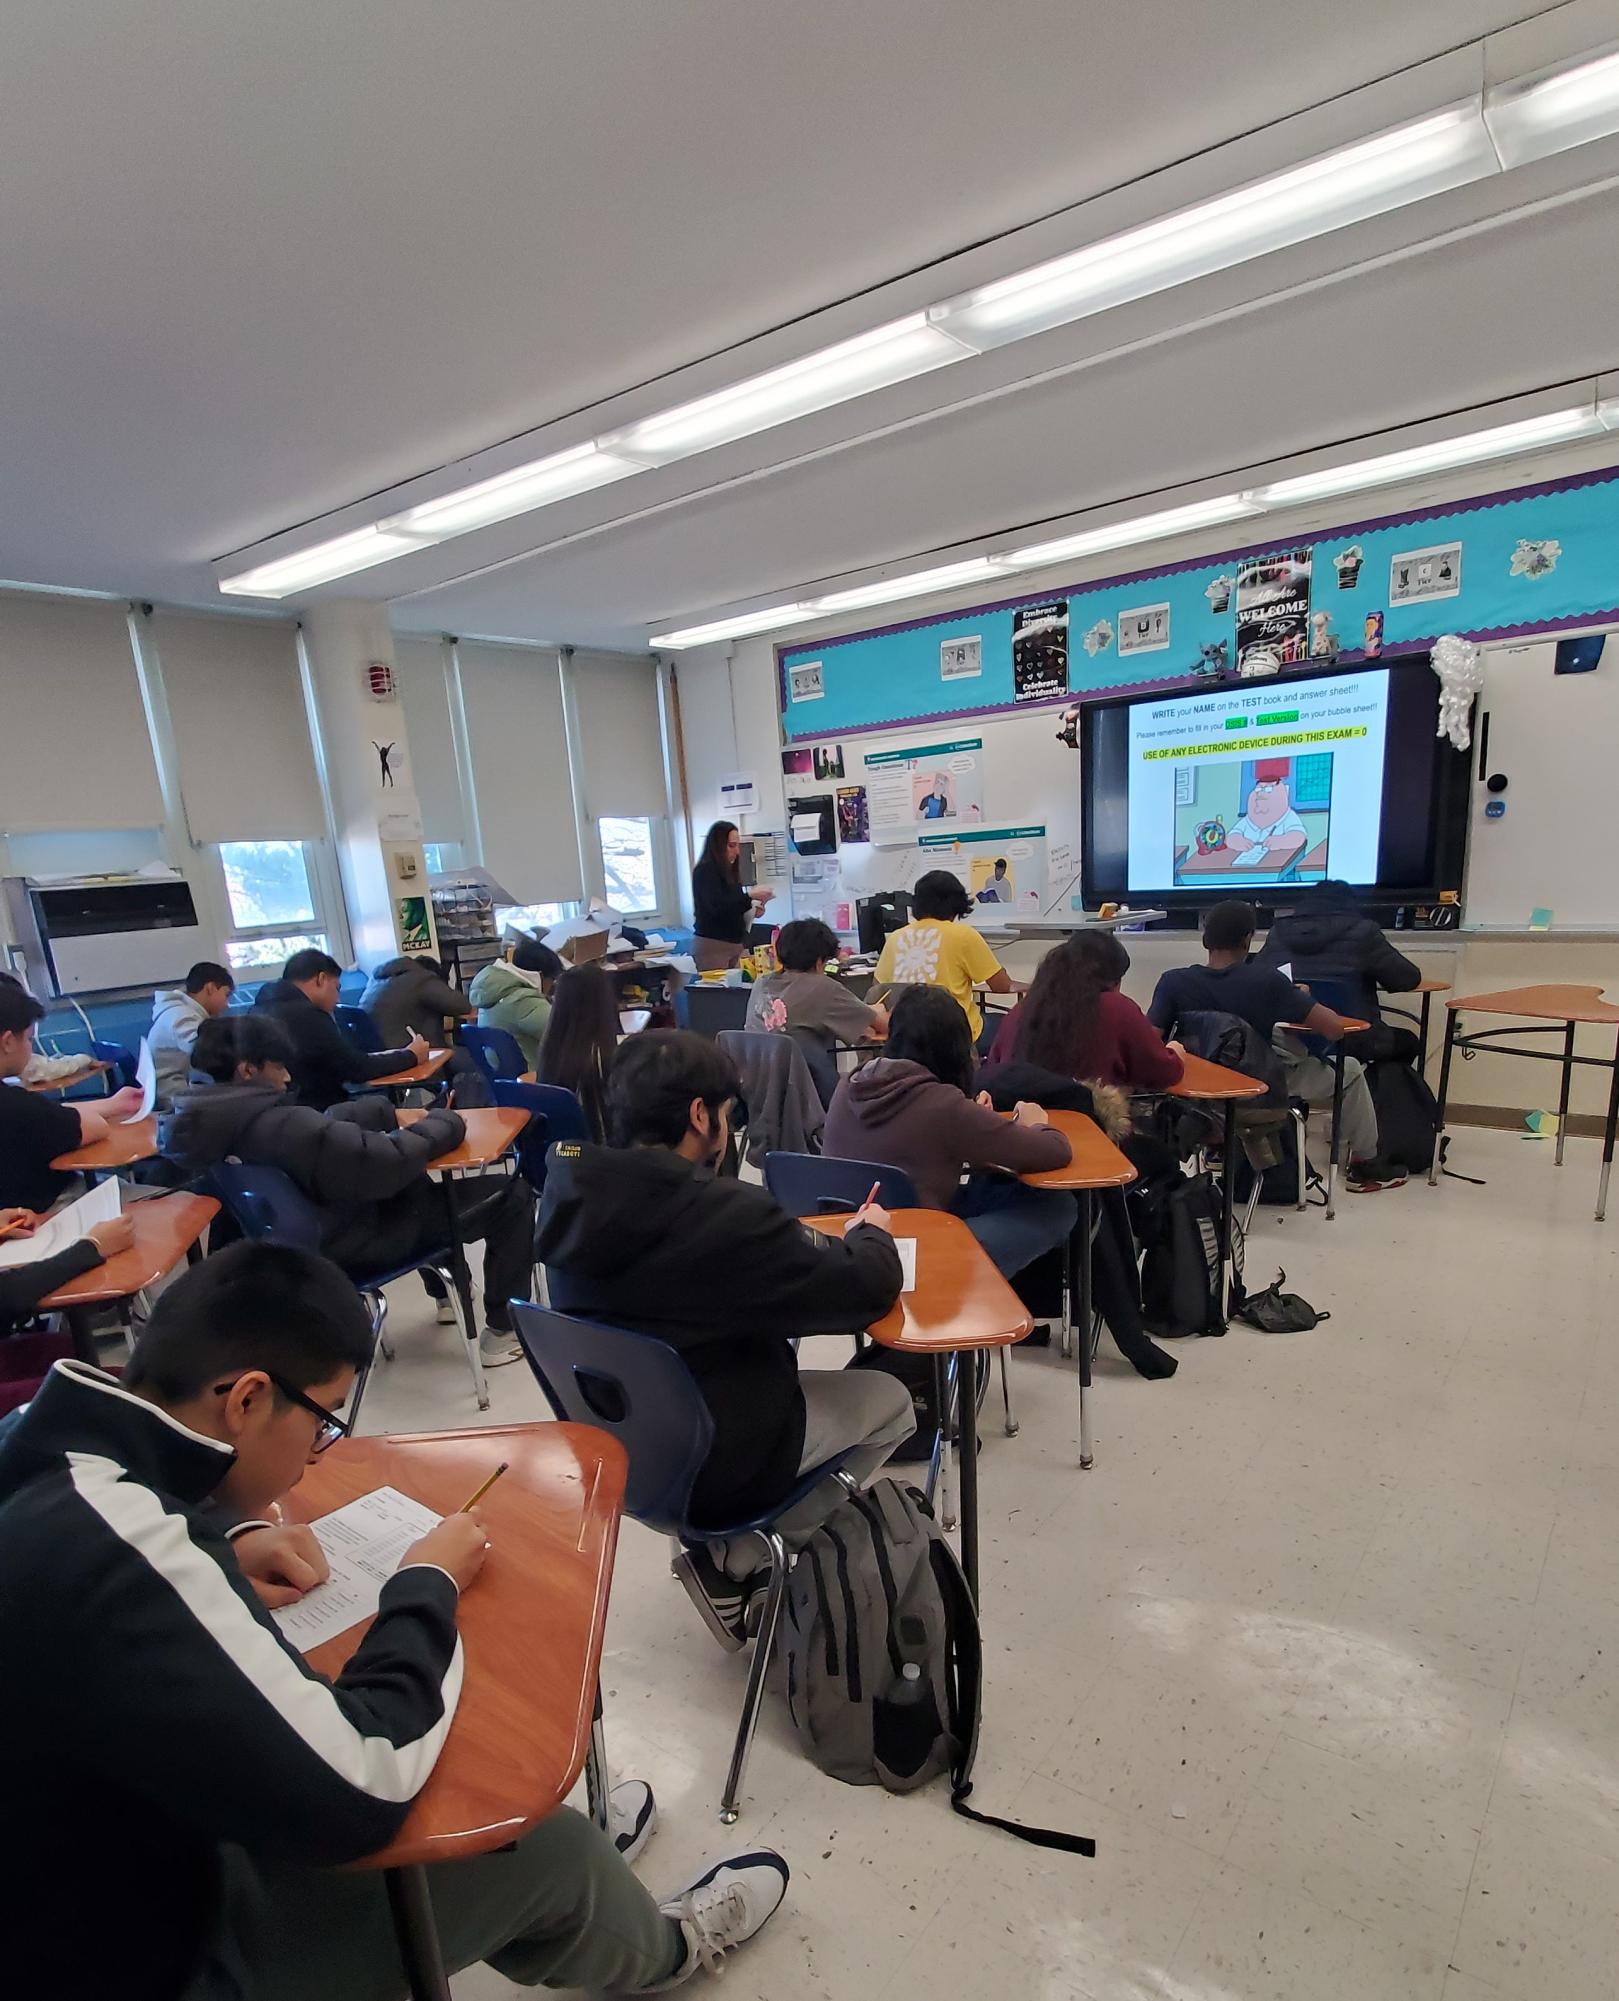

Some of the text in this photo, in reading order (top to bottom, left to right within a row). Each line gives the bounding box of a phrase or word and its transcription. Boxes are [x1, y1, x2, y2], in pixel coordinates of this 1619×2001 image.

[1022, 605, 1058, 619] Embrace
[1239, 599, 1308, 624] WELCOME
[1257, 621, 1288, 638] Here
[1015, 685, 1067, 701] Individuality
[1022, 678, 1059, 691] Celebrate
[1152, 709, 1176, 719] WRITE
[1177, 708, 1192, 718] your
[1193, 704, 1215, 714] NAME
[1228, 701, 1239, 710] the
[1241, 696, 1262, 707] TEST
[1263, 694, 1282, 704] book
[1283, 692, 1298, 702] and
[1300, 690, 1328, 700] answer
[1329, 684, 1359, 696] sheet!!!
[1136, 731, 1156, 739] Please
[1157, 727, 1187, 737] remember
[1210, 723, 1224, 732] your
[1272, 711, 1298, 722] Version
[1300, 712, 1309, 720] on
[1311, 709, 1326, 720] your
[1327, 705, 1351, 716] bubble
[1143, 750, 1158, 760] USE
[1159, 749, 1170, 758] OF
[1172, 747, 1186, 757] ANY
[1188, 741, 1237, 755] ELECTRONIC
[1239, 738, 1269, 749] DEVICE
[1270, 734, 1303, 746] DURING
[1306, 731, 1325, 742] THIS
[1327, 728, 1352, 740] EXAM
